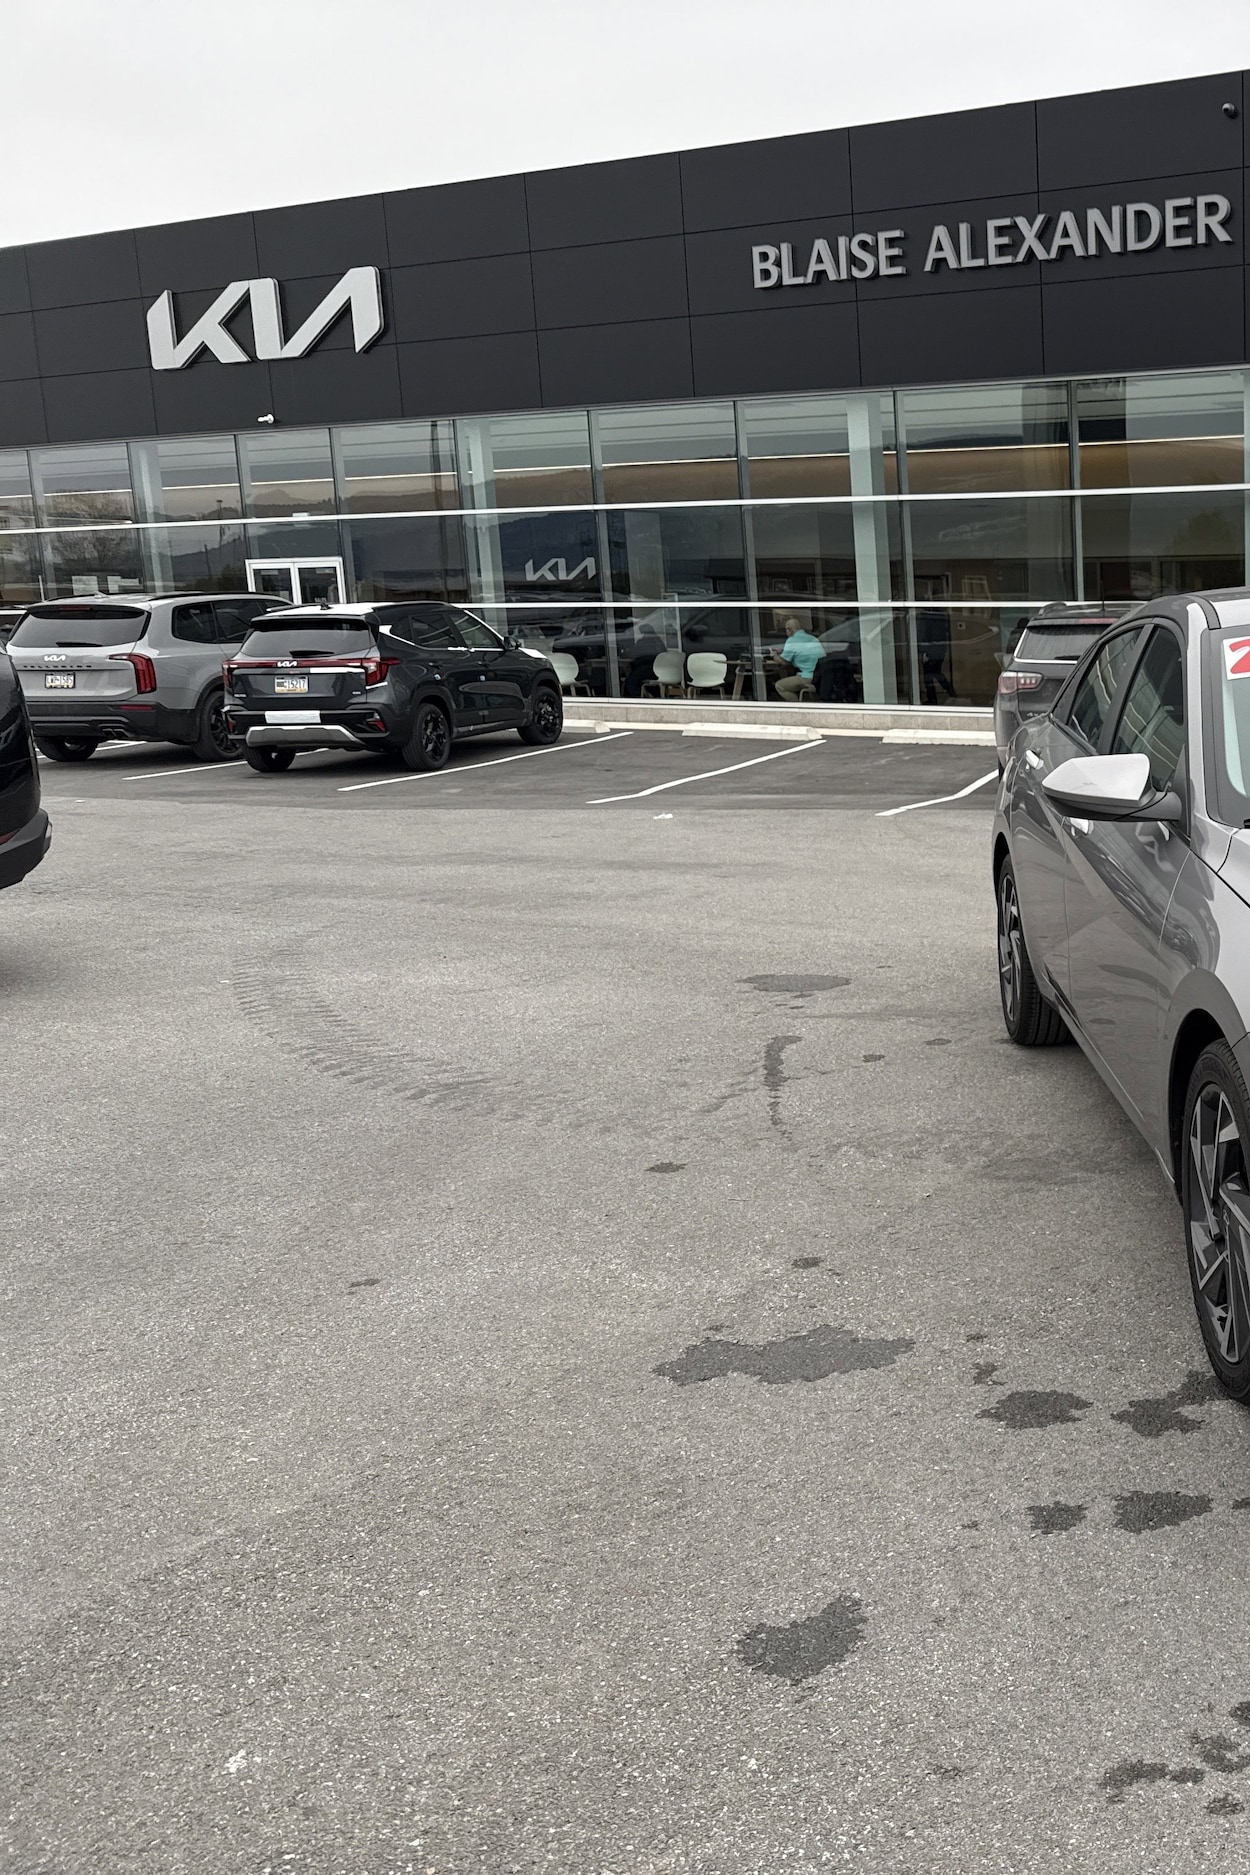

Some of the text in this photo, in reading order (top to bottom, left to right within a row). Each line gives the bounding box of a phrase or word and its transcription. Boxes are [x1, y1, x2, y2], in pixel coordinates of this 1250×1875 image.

[751, 194, 1233, 289] BLAISE ALEXANDER
[146, 265, 385, 370] KIA
[525, 557, 596, 581] KIA
[44, 654, 66, 662] KIA
[277, 660, 298, 668] KIA
